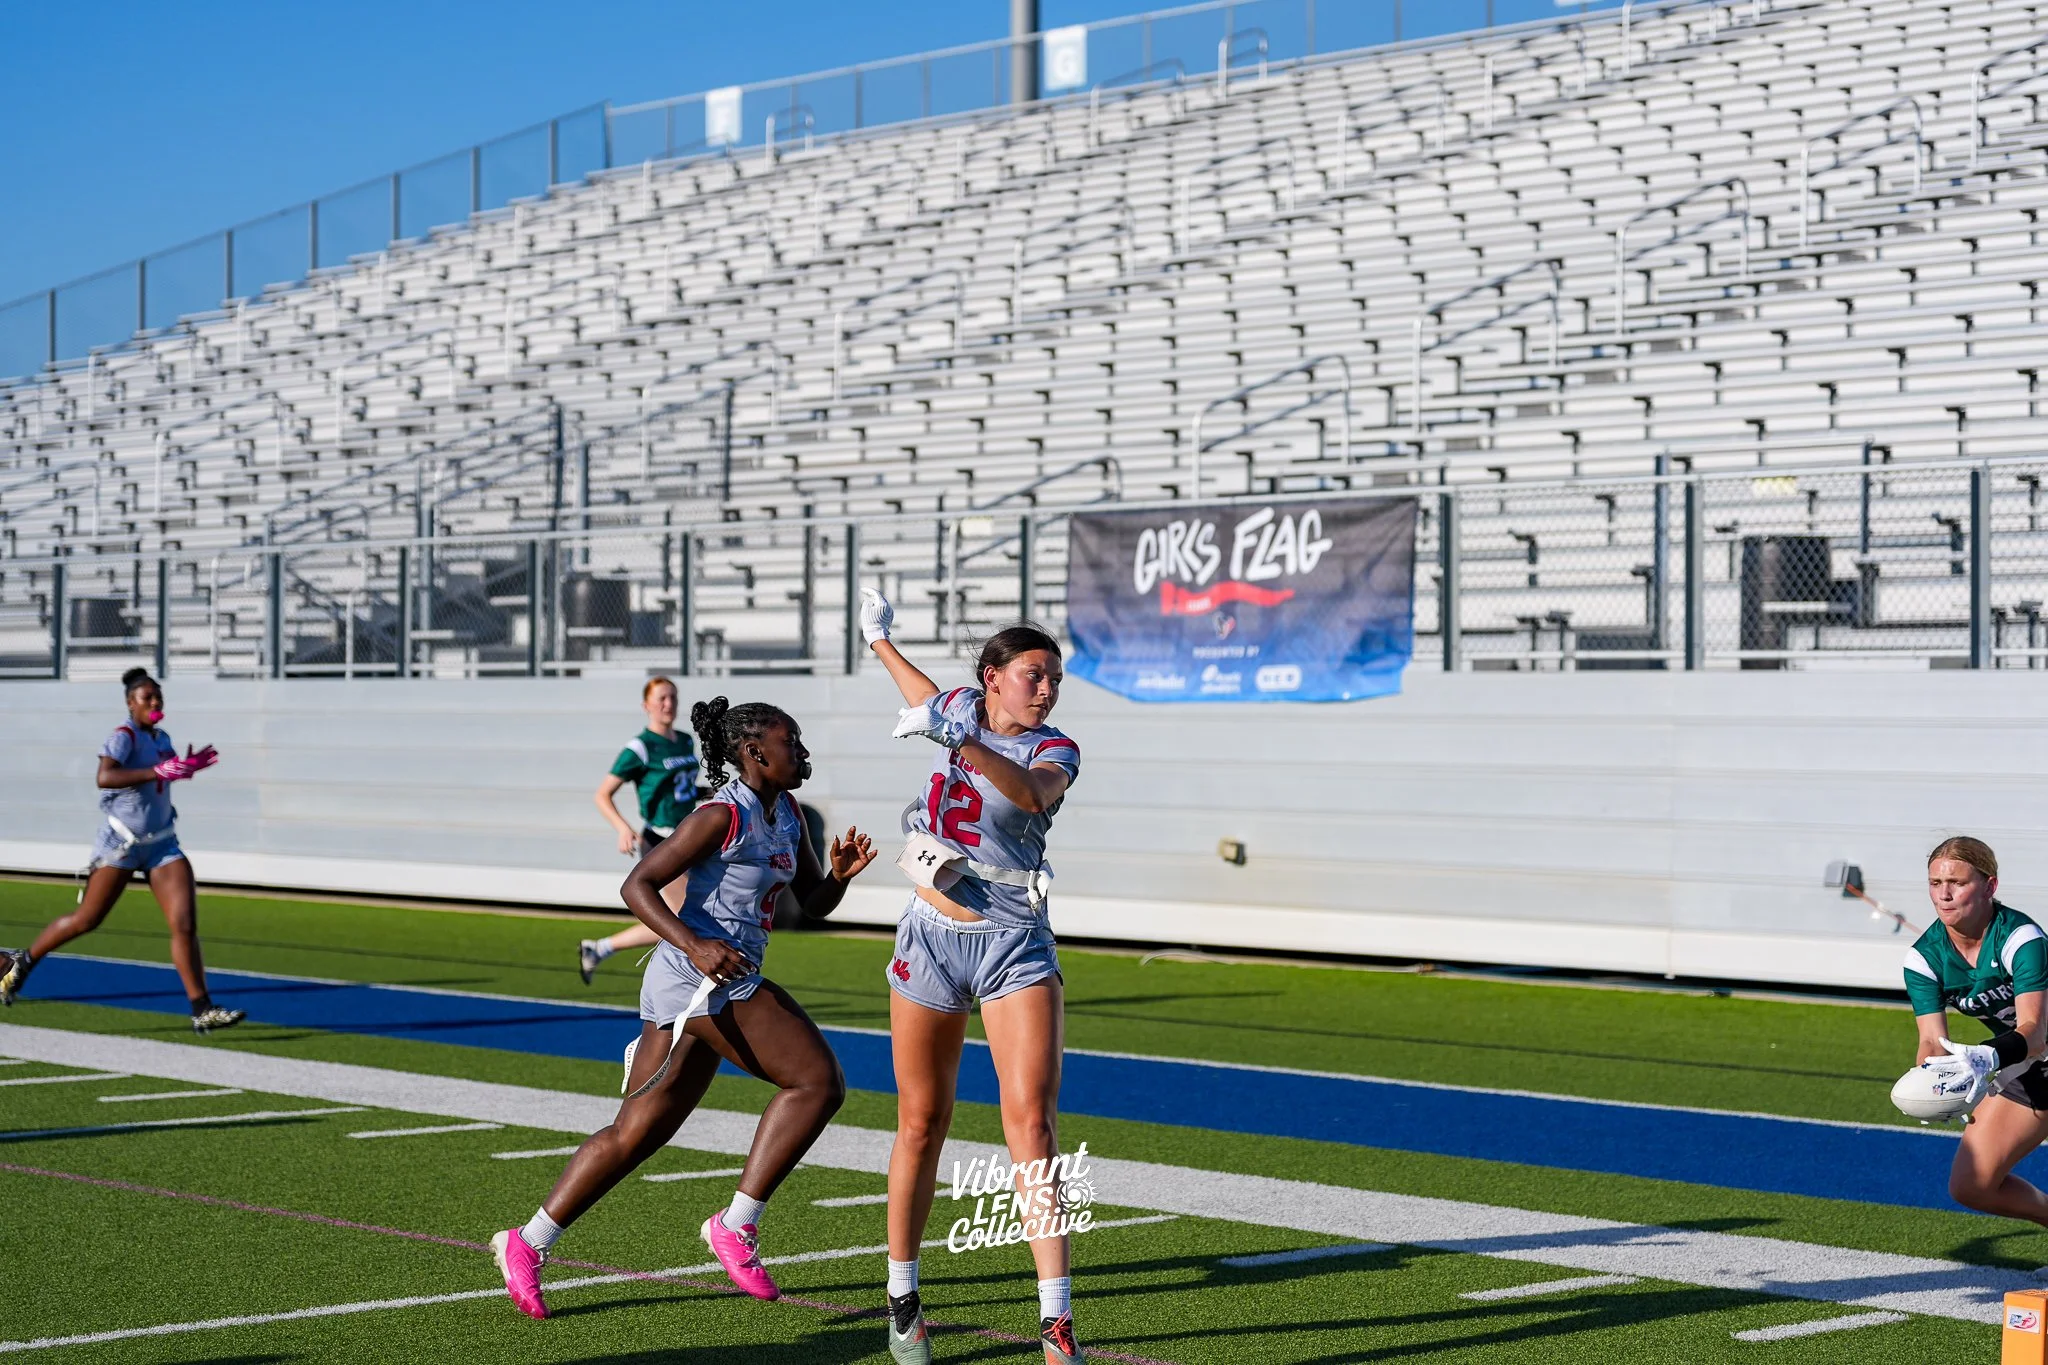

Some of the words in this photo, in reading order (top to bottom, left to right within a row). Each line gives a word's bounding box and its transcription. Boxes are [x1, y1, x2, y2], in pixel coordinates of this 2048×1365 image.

[1054, 48, 1079, 80] G
[1134, 518, 1221, 594] GIRLS
[1229, 507, 1333, 581] FLAG
[927, 772, 983, 847] 12
